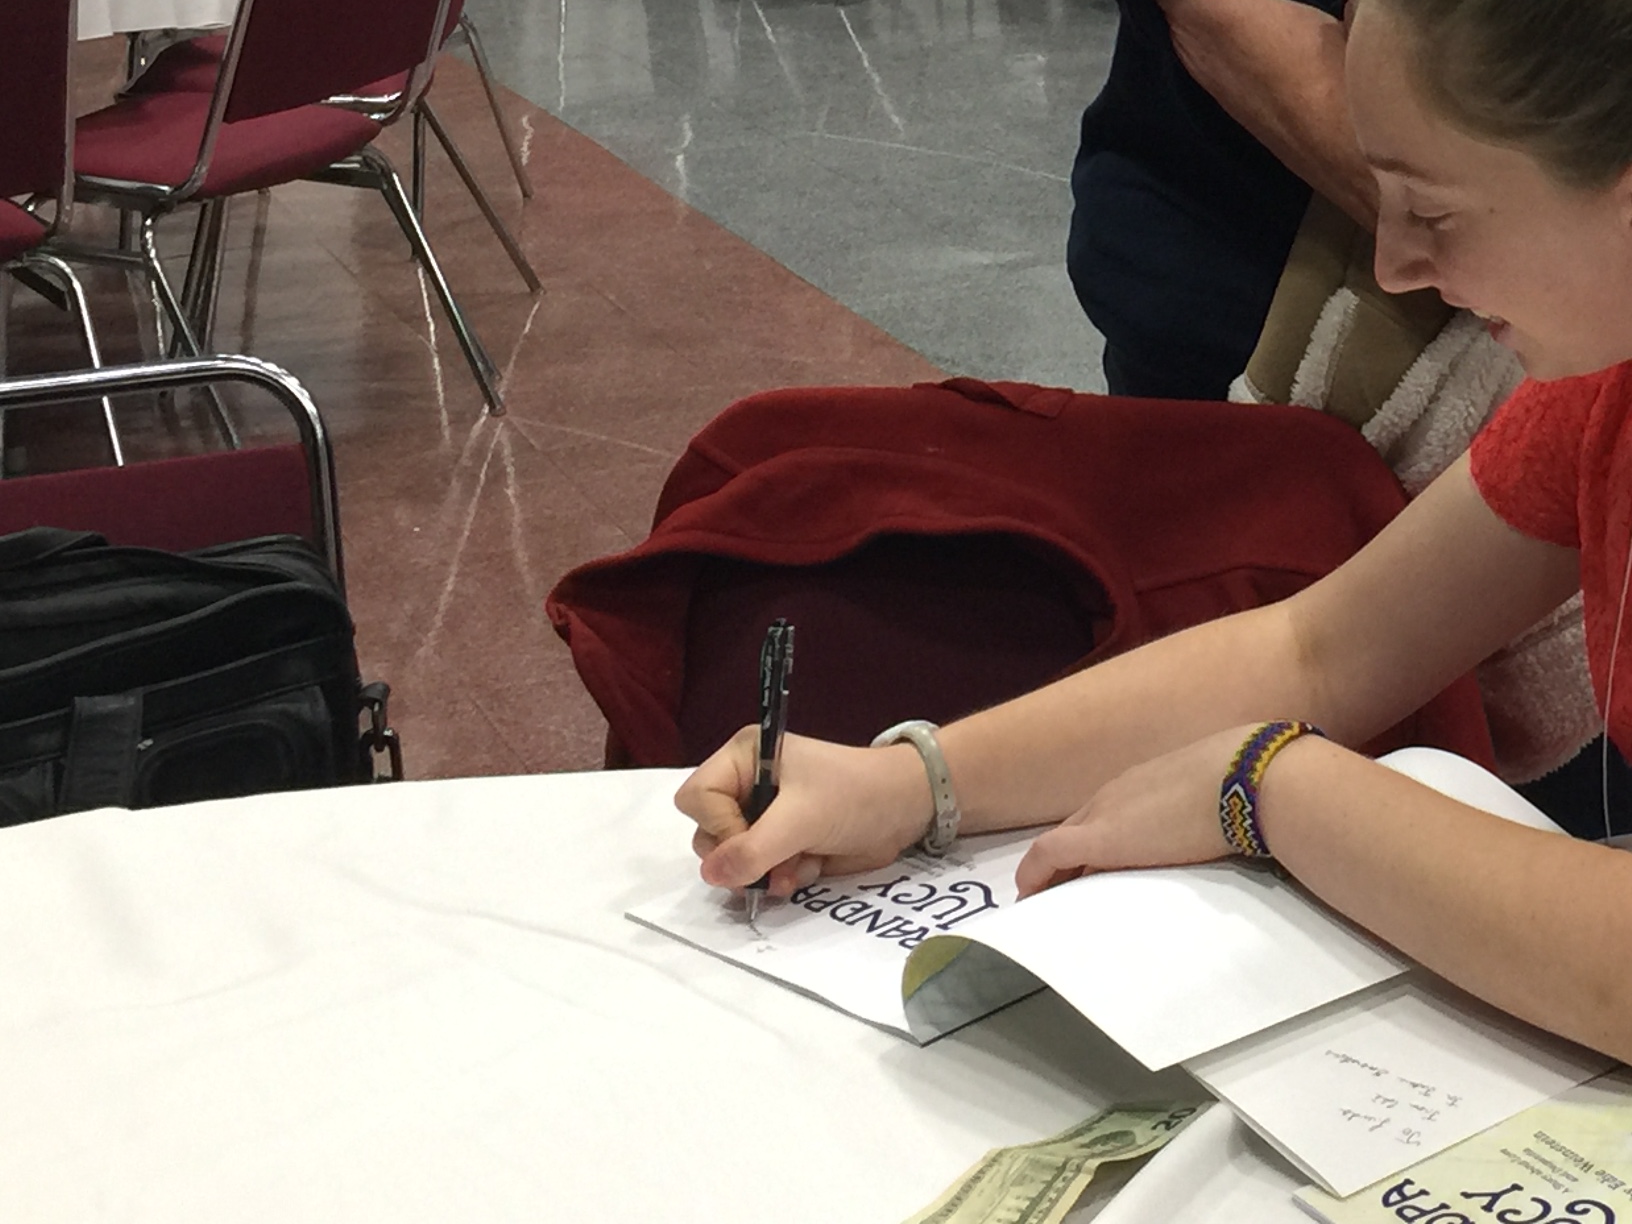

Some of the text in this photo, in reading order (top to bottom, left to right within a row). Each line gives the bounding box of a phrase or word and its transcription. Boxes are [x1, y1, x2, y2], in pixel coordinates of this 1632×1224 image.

[790, 883, 930, 950] RANDPA
[858, 876, 999, 930] LUCY
[1151, 1107, 1197, 1131] 20
[1533, 1130, 1594, 1173] Weinstein
[1595, 1169, 1626, 1190] Edie
